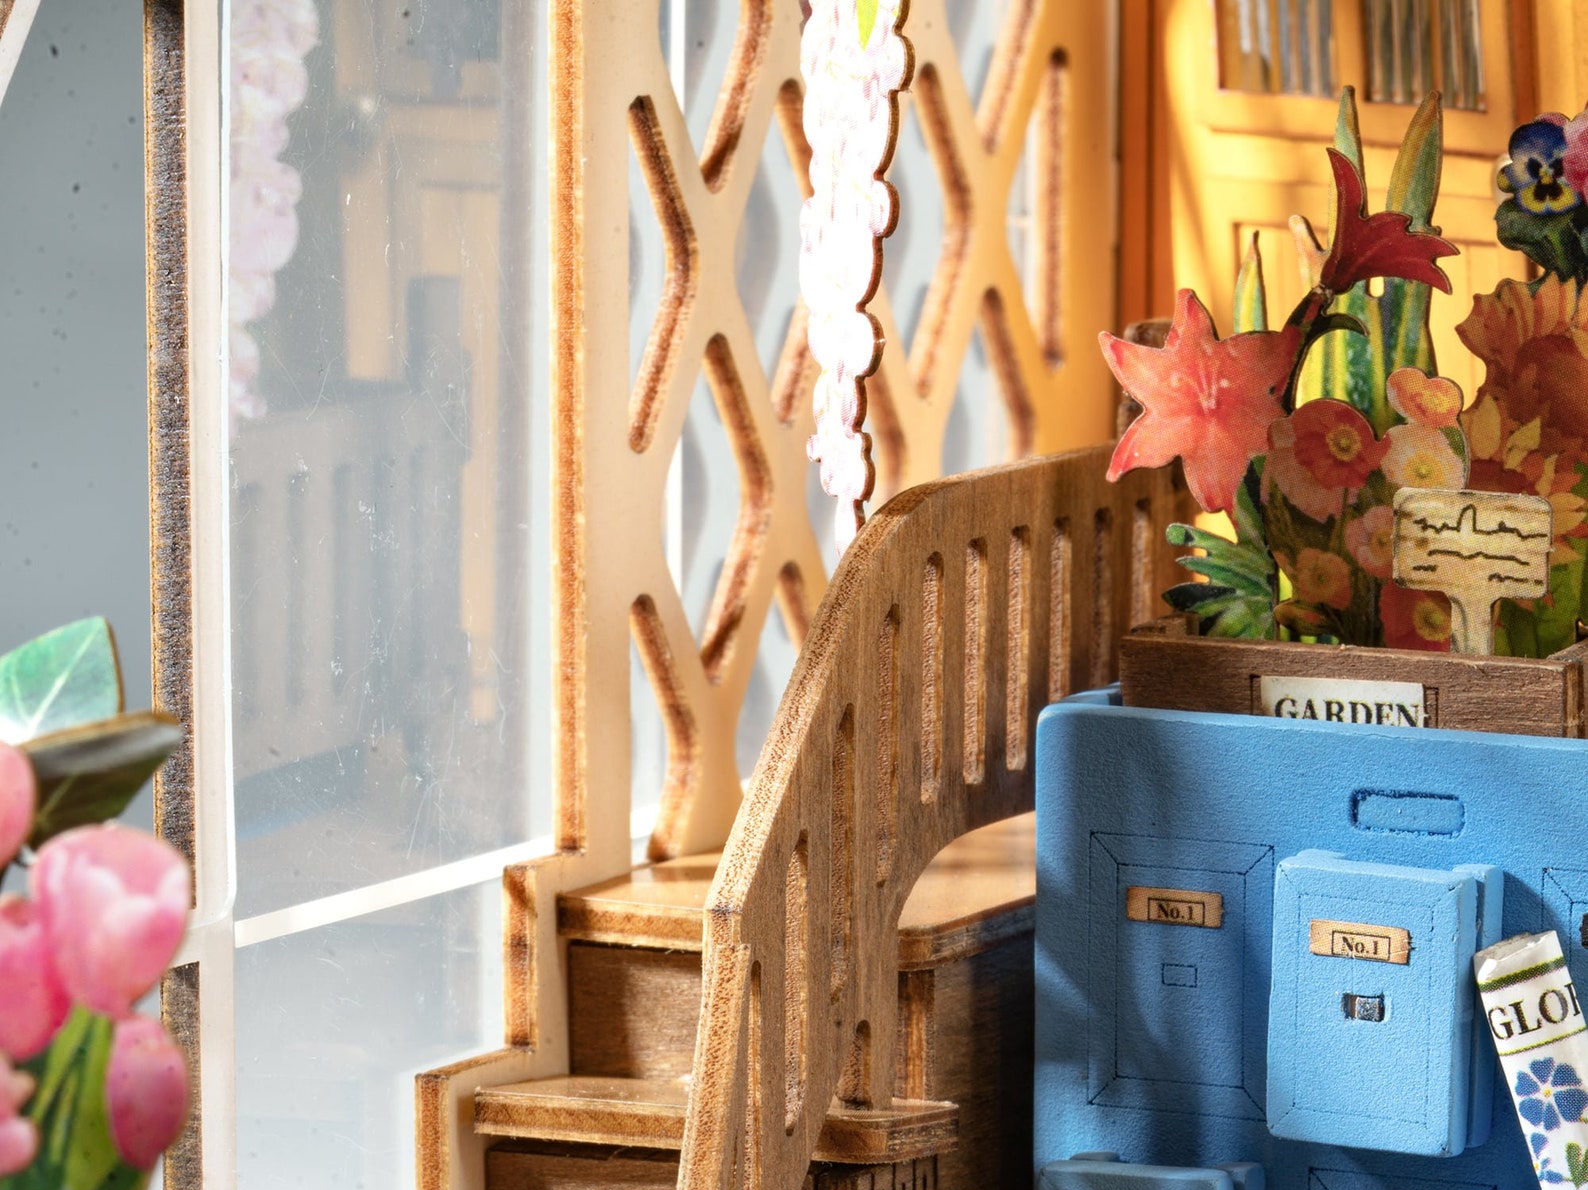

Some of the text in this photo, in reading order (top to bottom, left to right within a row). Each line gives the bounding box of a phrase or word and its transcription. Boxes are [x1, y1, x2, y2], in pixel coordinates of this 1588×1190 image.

[1274, 697, 1420, 728] GARDEN
[1157, 902, 1195, 921] No.1
[1342, 936, 1380, 956] No.1
